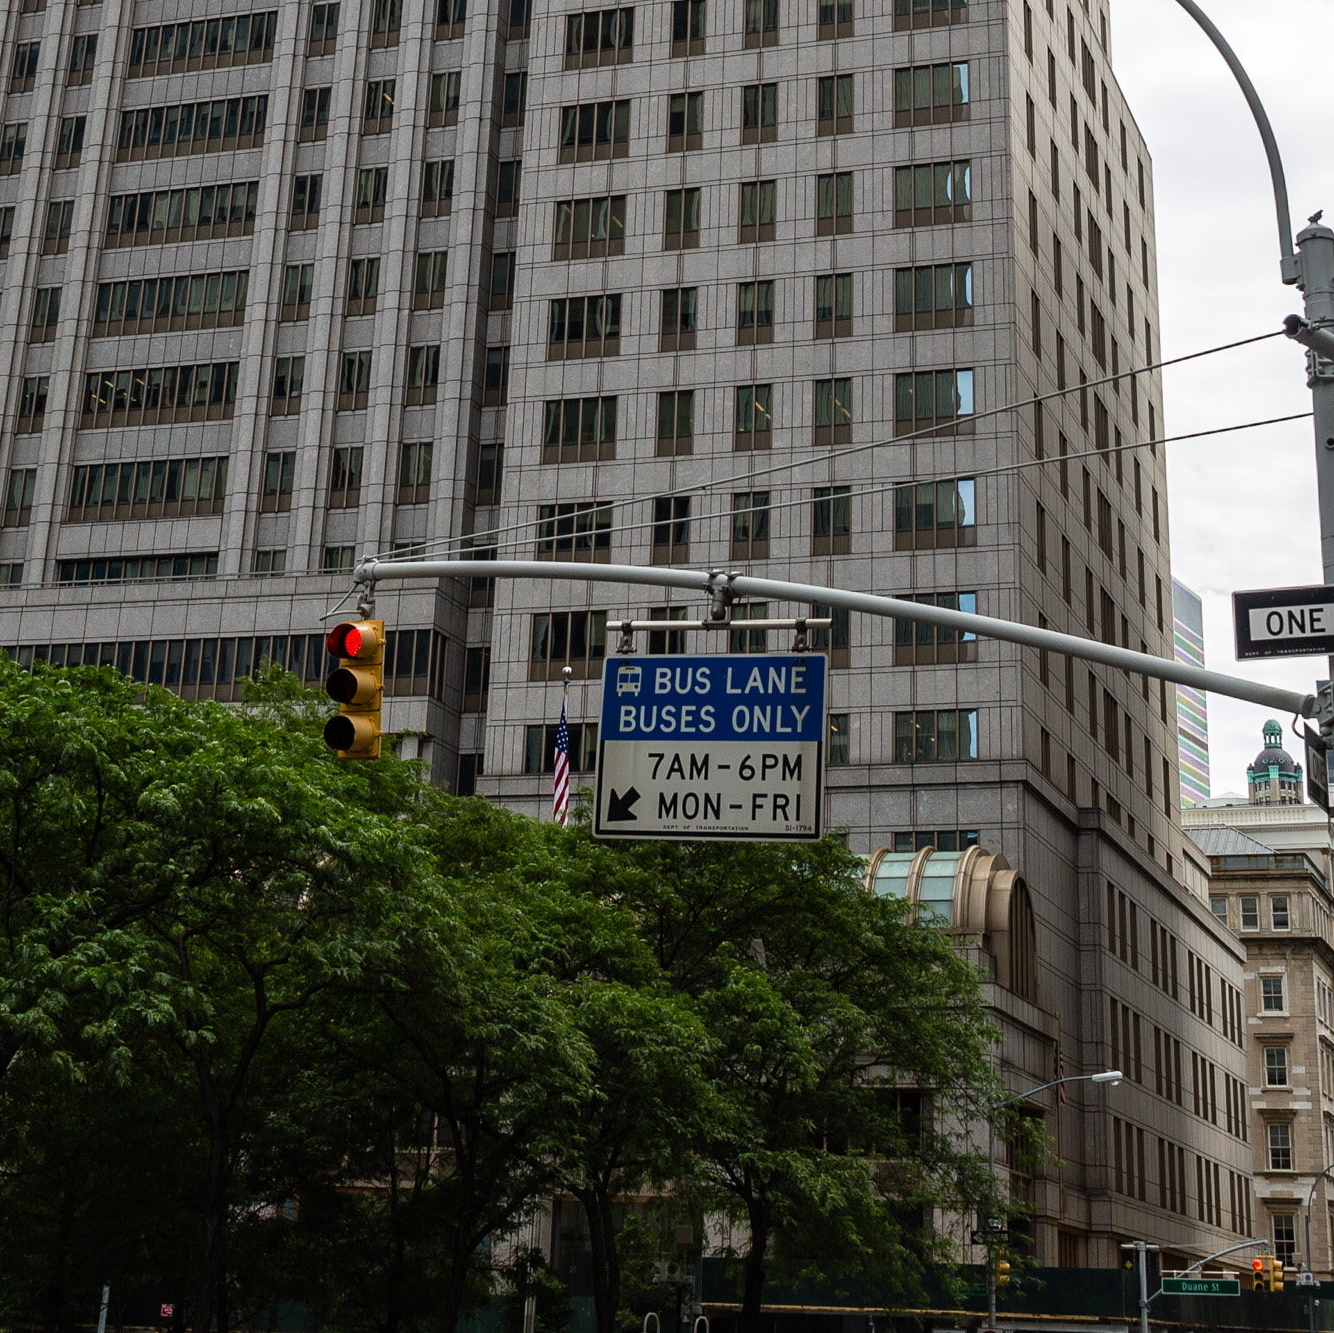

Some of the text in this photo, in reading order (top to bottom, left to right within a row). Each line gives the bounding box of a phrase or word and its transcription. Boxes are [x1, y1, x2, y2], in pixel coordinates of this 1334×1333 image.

[1265, 607, 1327, 637] ONE
[654, 666, 808, 695] BUS LANE
[619, 704, 812, 734] BUSES ONLY
[1181, 1281, 1220, 1292] Duane St
